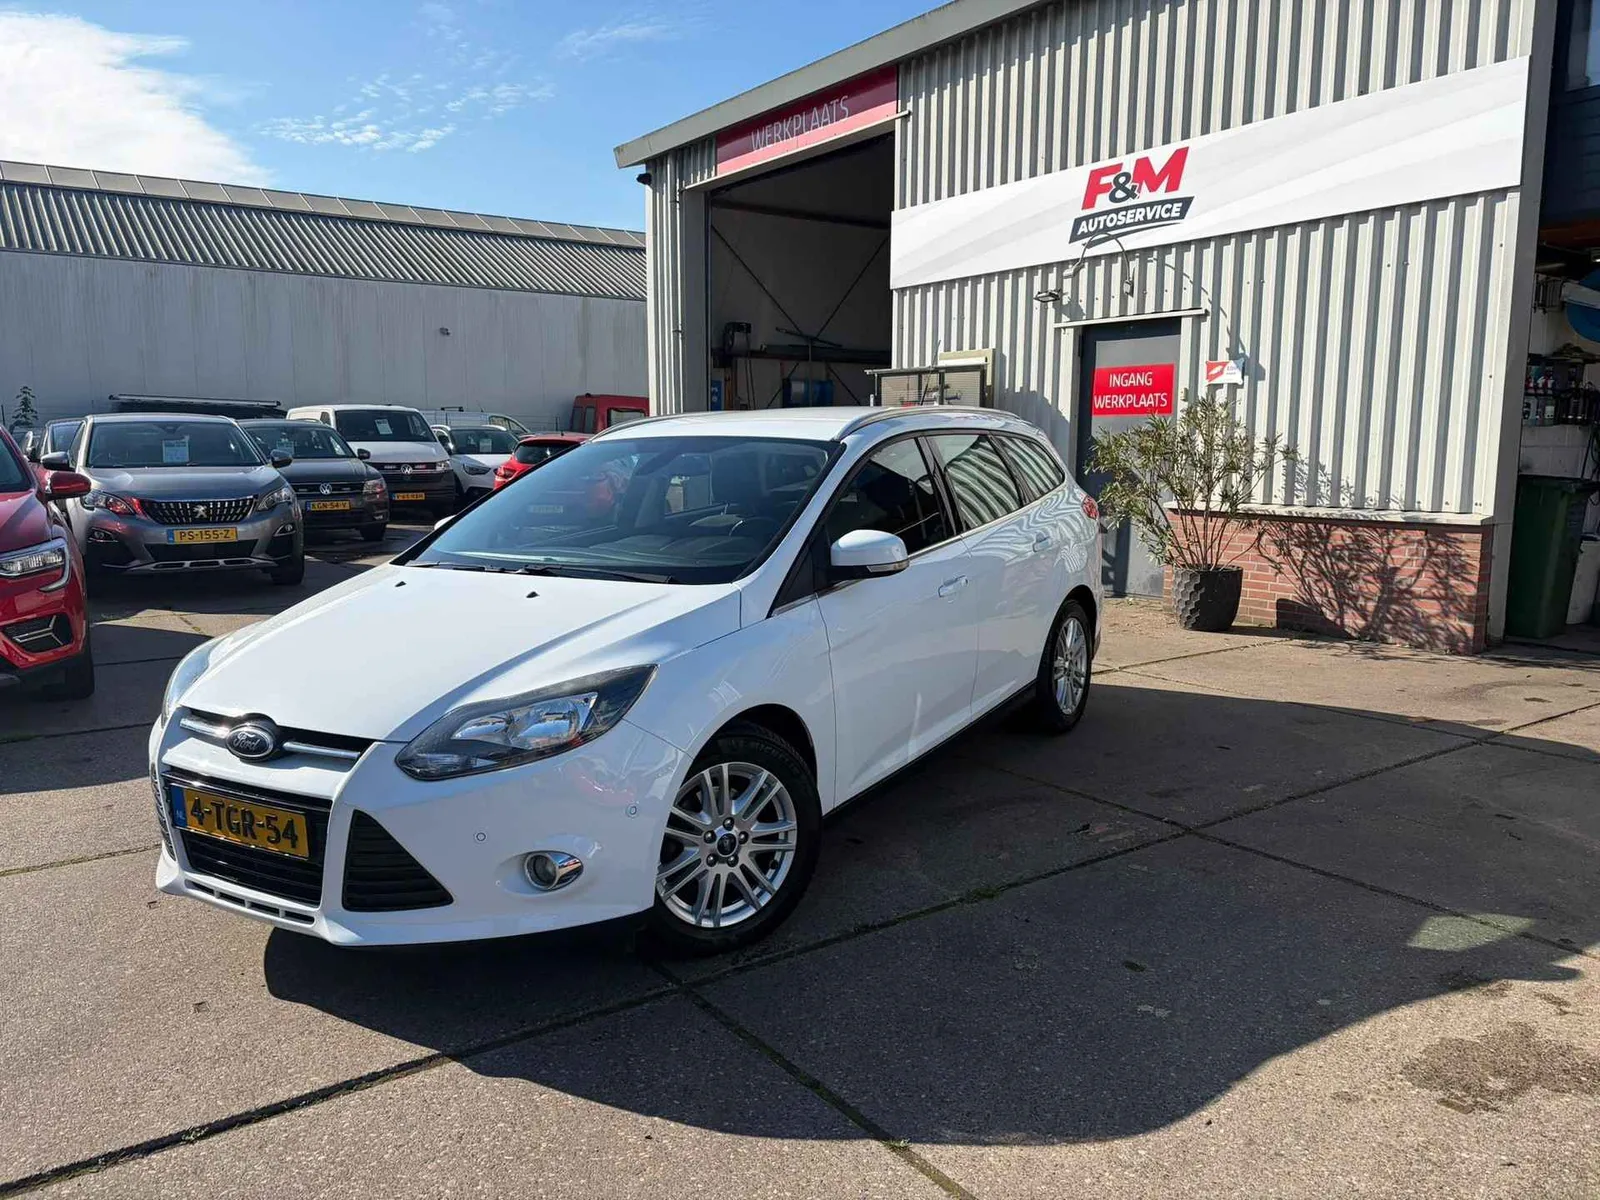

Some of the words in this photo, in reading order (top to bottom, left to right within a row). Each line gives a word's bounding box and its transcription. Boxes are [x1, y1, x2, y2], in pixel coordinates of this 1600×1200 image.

[751, 95, 849, 151] WERKPLAATS
[1081, 146, 1190, 210] F&M
[1077, 202, 1183, 236] AUTOSERVICE
[1109, 371, 1153, 388] INGANG
[1093, 393, 1168, 409] WERKPLAATS
[179, 529, 231, 541] PS-155-Z
[232, 731, 262, 752] Ford
[190, 796, 299, 849] 4-TGR-54
